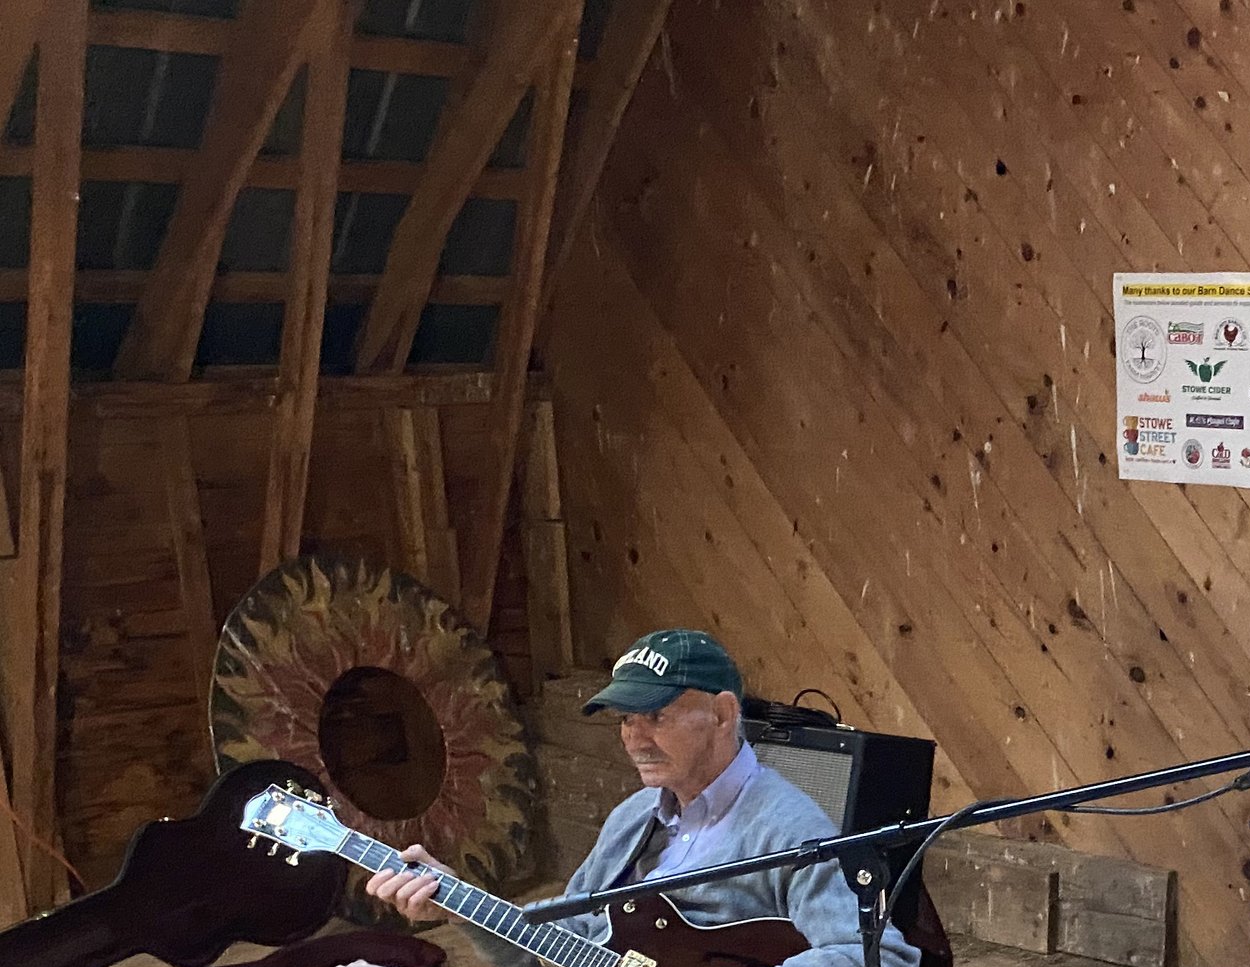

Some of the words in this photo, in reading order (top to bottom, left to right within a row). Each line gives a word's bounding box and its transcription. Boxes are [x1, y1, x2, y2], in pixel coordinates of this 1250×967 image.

[1122, 286, 1143, 297] Many
[1144, 287, 1171, 296] thanks
[1172, 287, 1181, 296] to
[1182, 287, 1196, 296] our
[1198, 286, 1217, 296] Barn
[1219, 286, 1246, 296] Dance
[1182, 385, 1207, 394] STOWE
[1208, 386, 1232, 395] CIDER
[1139, 417, 1173, 430] STOWE
[1139, 431, 1177, 444] STREET
[1140, 443, 1166, 457] CAFE
